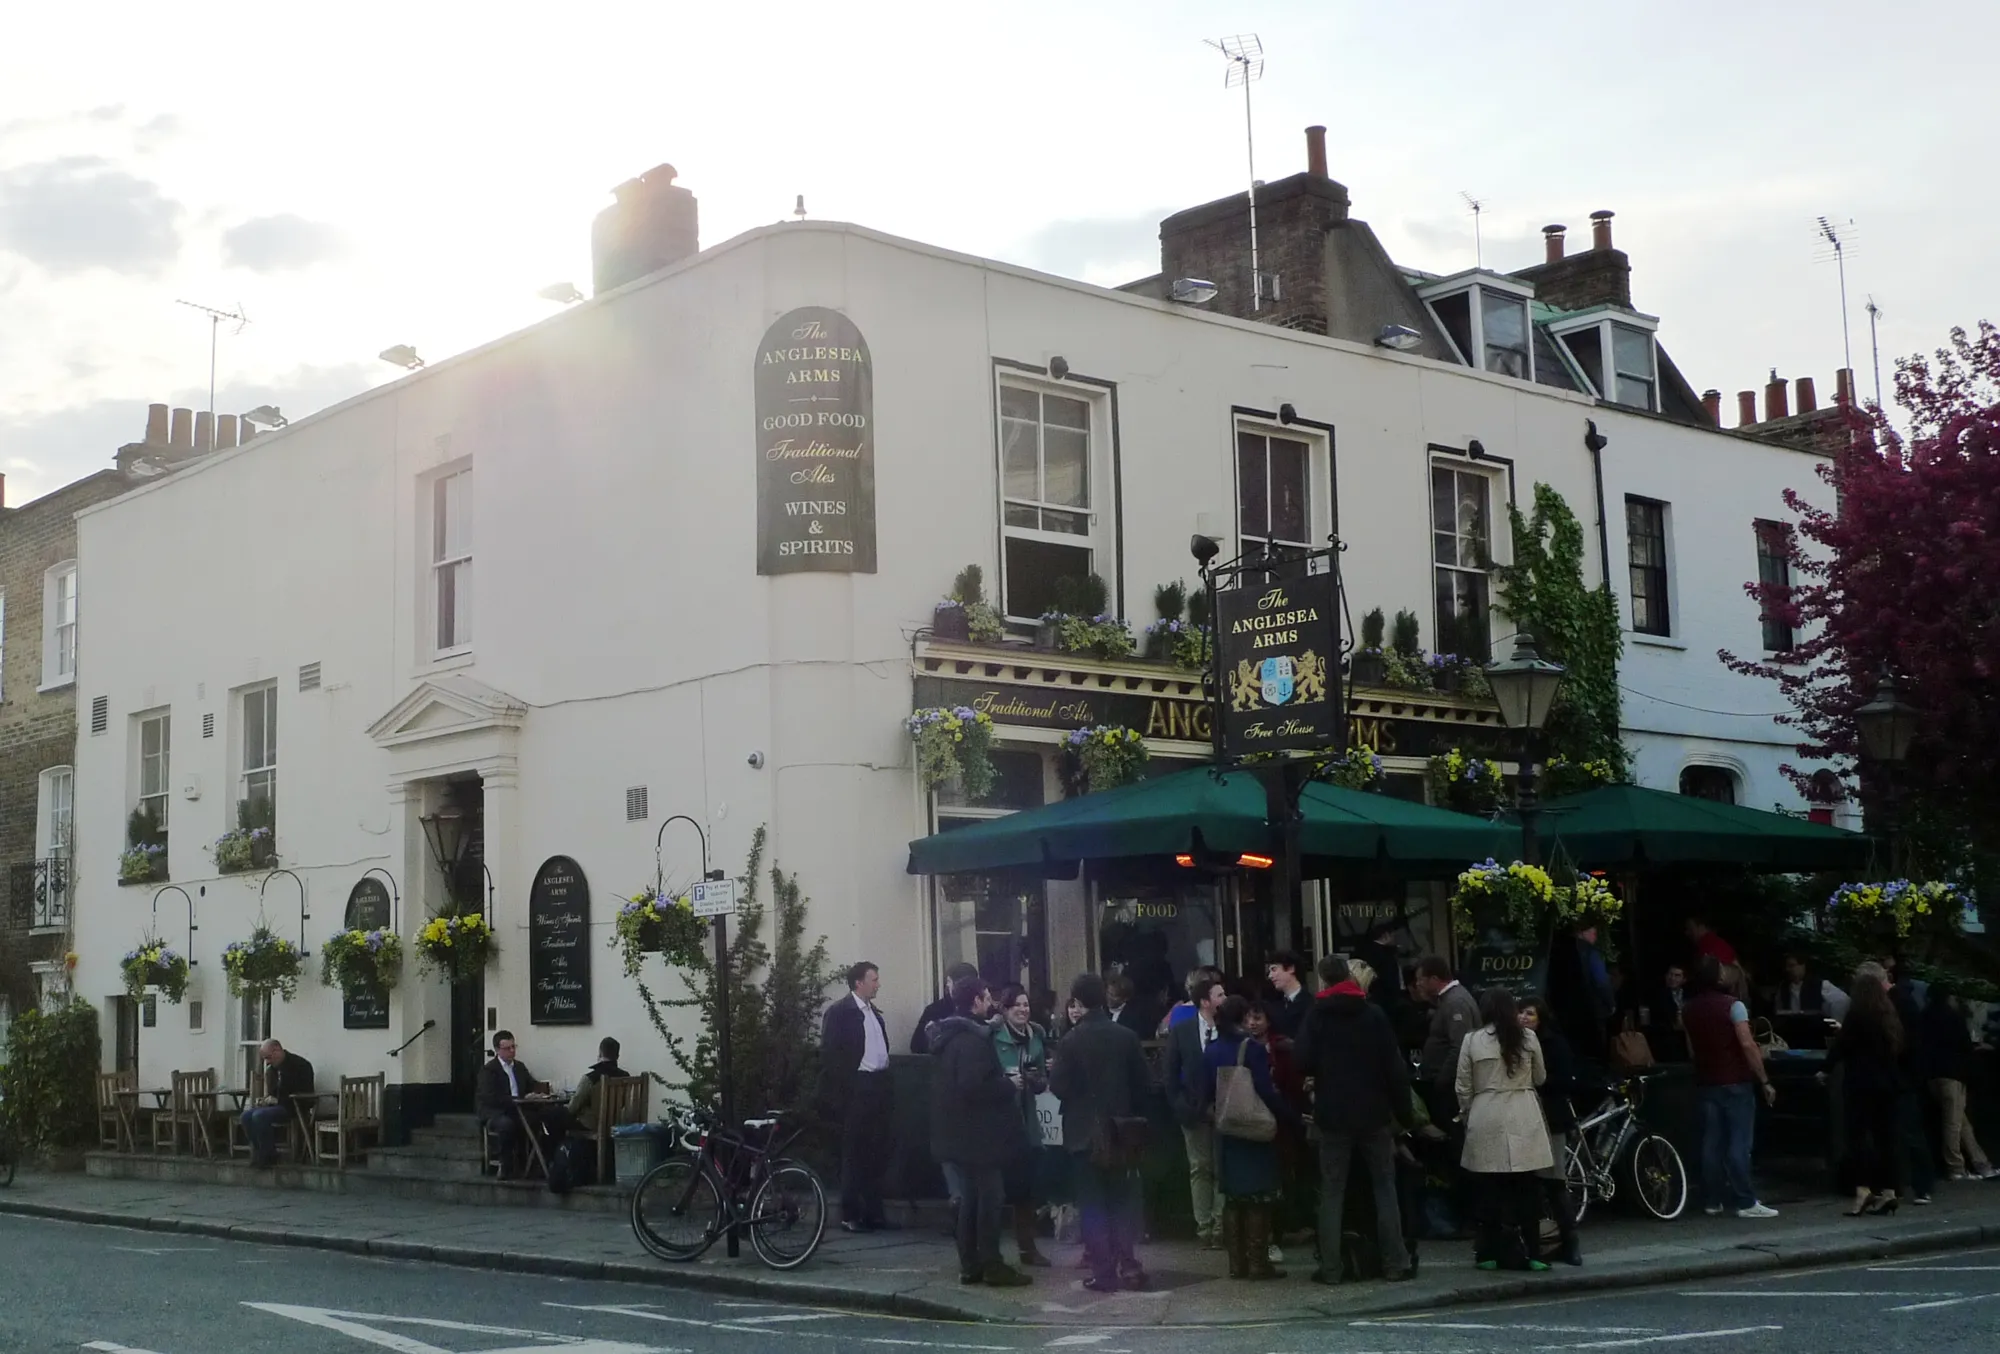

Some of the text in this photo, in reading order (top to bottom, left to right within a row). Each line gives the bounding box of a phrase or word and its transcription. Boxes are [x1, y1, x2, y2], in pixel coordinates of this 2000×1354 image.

[791, 321, 828, 340] The
[762, 347, 863, 365] ANGLESEA
[786, 369, 841, 384] ARMS
[763, 412, 866, 431] GOOD FOOD
[766, 438, 863, 461] Traditional
[790, 463, 835, 485] Ales
[785, 501, 847, 516] WINES
[808, 520, 824, 535] &
[779, 540, 854, 556] SPIRITS
[1257, 588, 1289, 610] The
[1231, 607, 1319, 634] ANGLESEA
[1252, 629, 1299, 649] ARMS
[972, 691, 1094, 722] Traditional Ales
[1244, 718, 1315, 739] Free House
[1347, 717, 1396, 751] MS
[543, 875, 575, 886] ANGLESEA
[550, 888, 568, 896] ARMS
[696, 886, 704, 900] P
[1136, 904, 1178, 918] FOOD
[1357, 904, 1383, 918] THE
[541, 936, 578, 948] Traditional
[1481, 955, 1534, 972] FOOD
